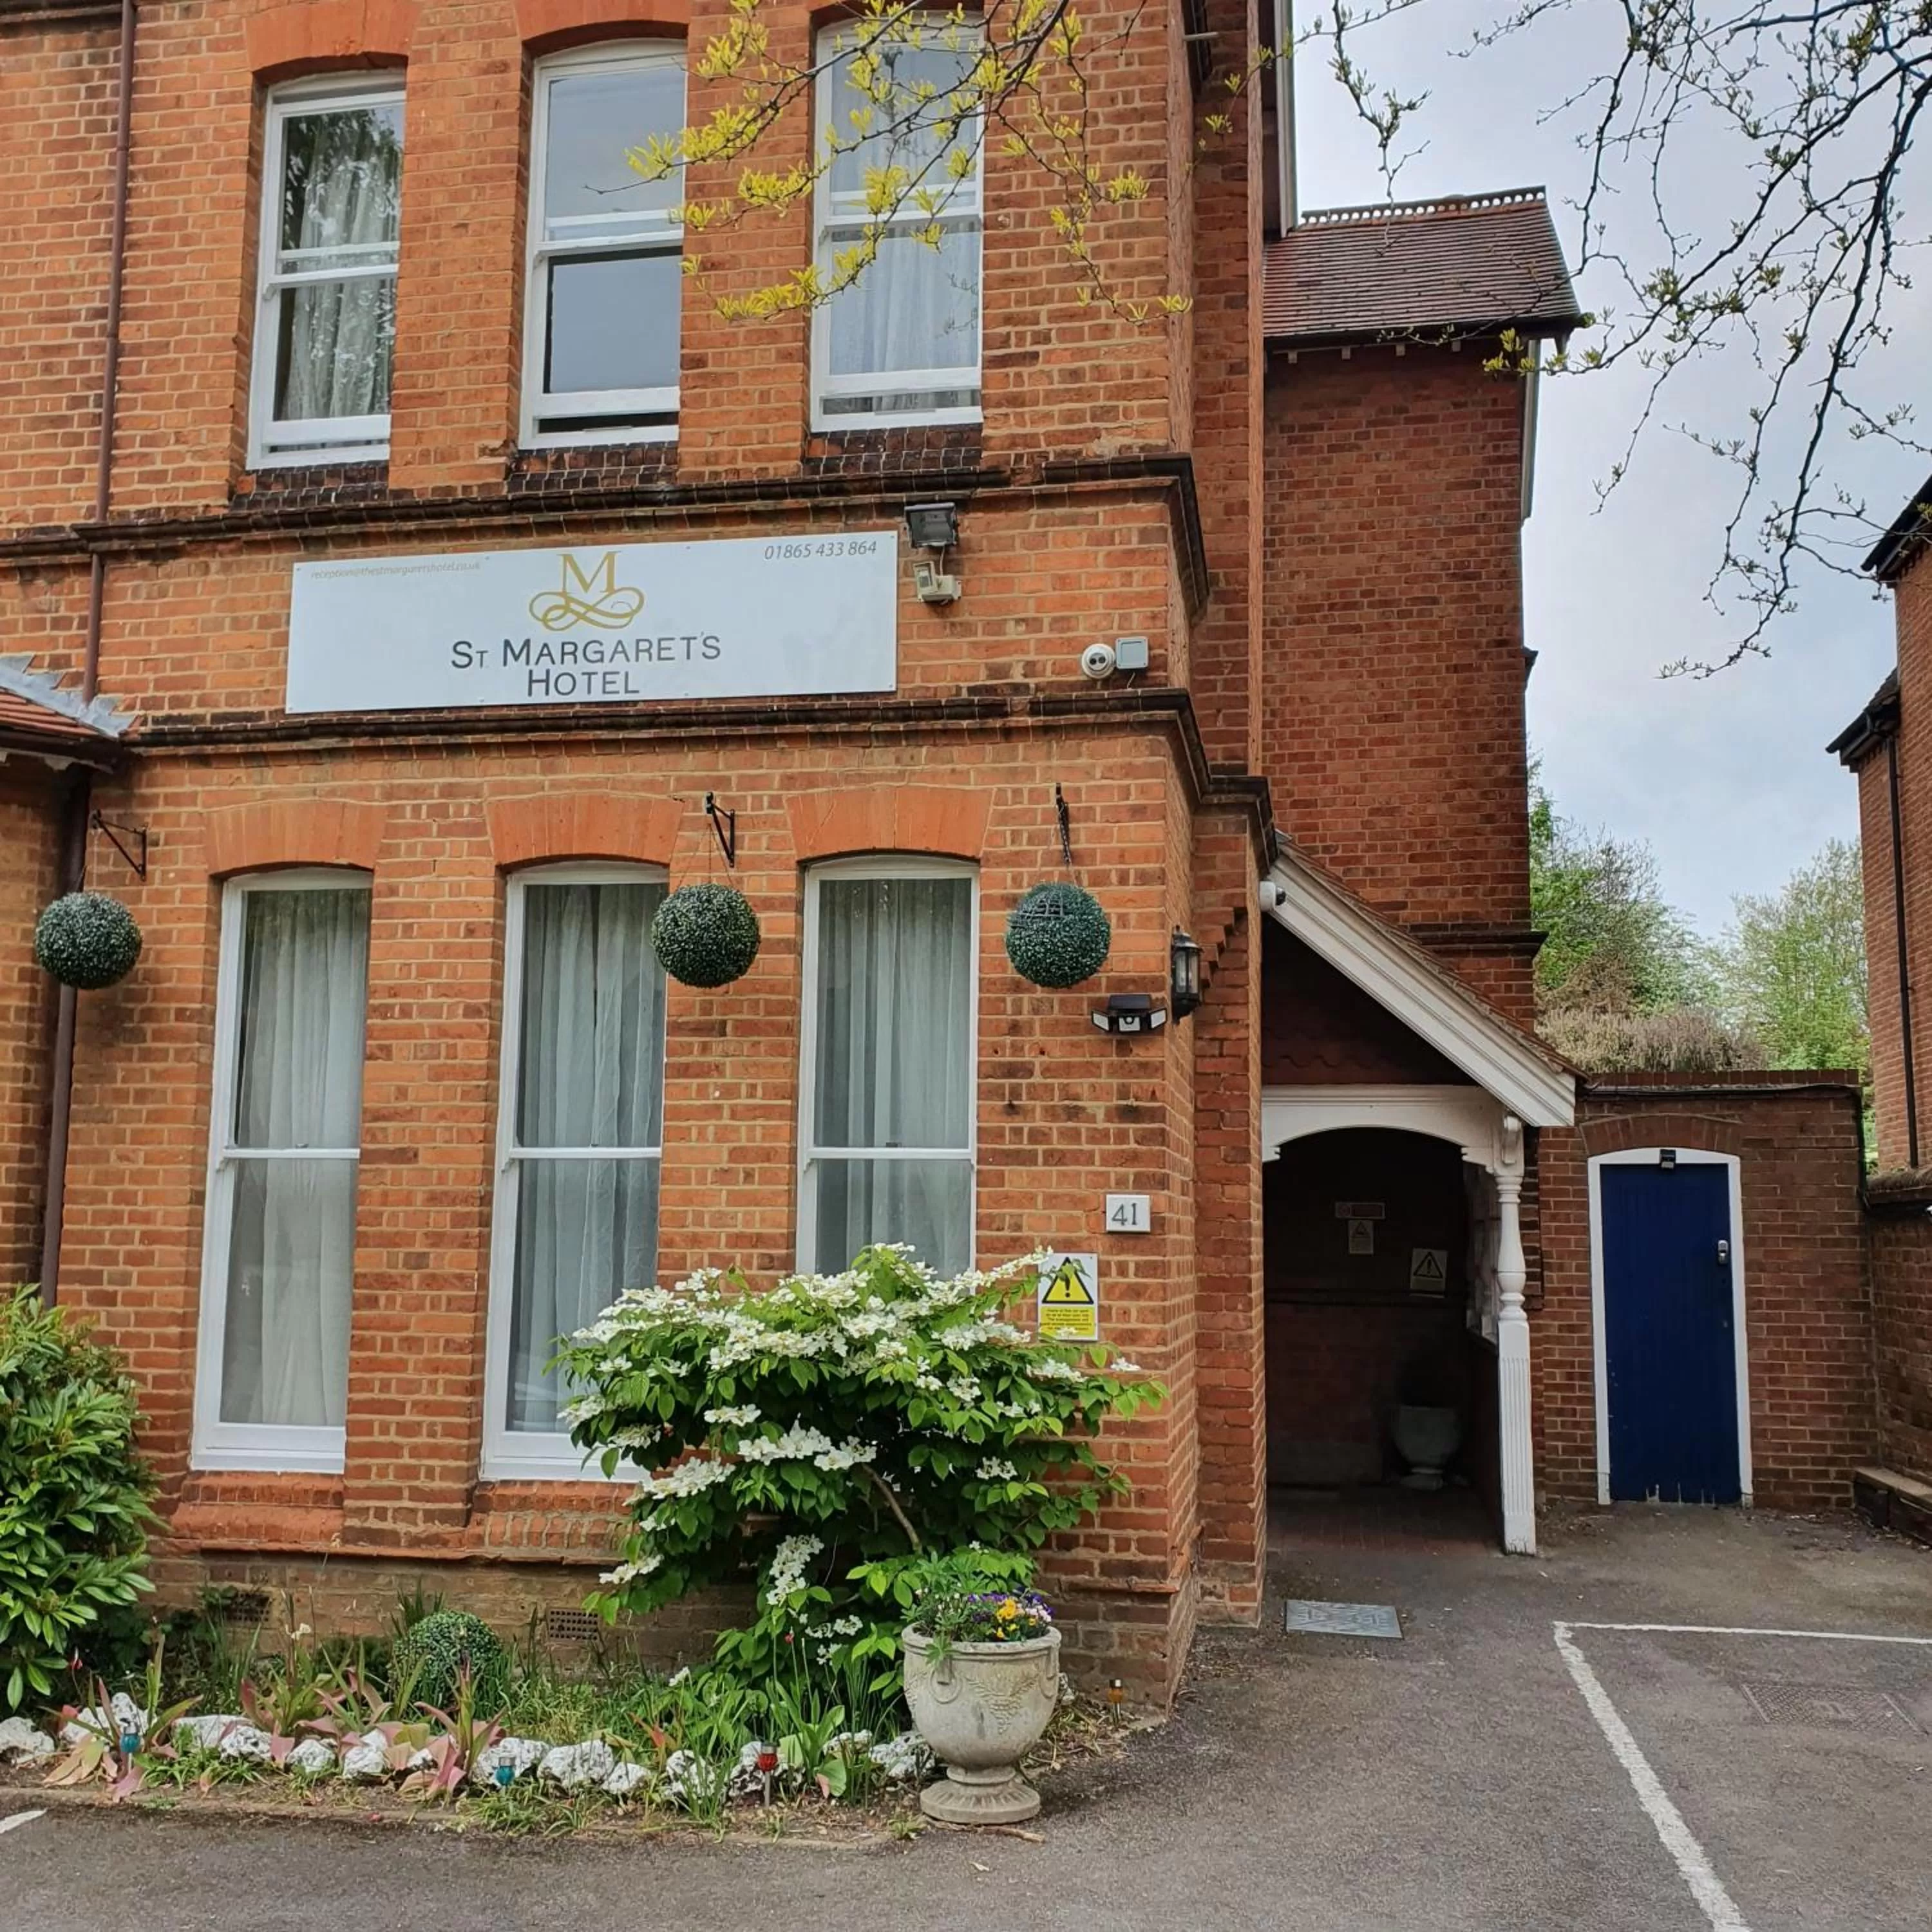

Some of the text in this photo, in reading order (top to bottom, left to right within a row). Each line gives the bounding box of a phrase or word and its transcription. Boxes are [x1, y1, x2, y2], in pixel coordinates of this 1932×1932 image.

[764, 540, 876, 560] 01865 433 864
[556, 551, 621, 593] M
[502, 632, 721, 667] MARGARET'S
[527, 668, 641, 697] HOTEL
[1111, 1202, 1138, 1226] 41
